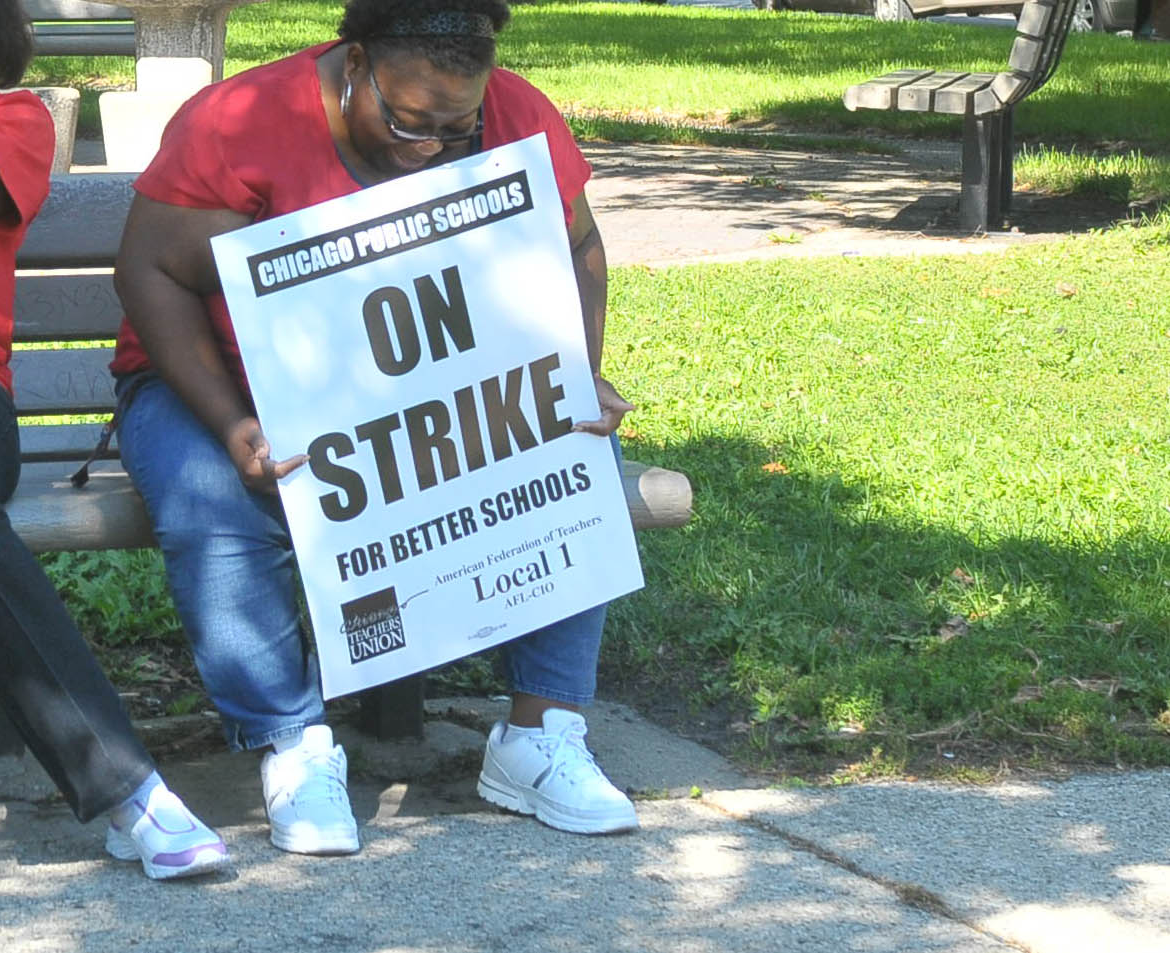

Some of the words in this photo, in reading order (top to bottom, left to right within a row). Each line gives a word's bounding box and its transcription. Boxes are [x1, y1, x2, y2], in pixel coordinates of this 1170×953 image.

[257, 237, 354, 287] CHICAGO
[354, 211, 431, 258] PUBLIC
[431, 181, 525, 233] SCHOOLS
[363, 266, 475, 376] ON
[307, 353, 573, 523] STRIKE
[337, 542, 387, 581] FOR
[390, 507, 478, 564] BETTER
[480, 463, 591, 528] SCHOOLS
[434, 562, 485, 587] American
[486, 539, 541, 566] Federation
[543, 531, 553, 544] of
[555, 516, 603, 539] Teachers
[471, 550, 552, 603] Local
[558, 542, 574, 570] 1
[504, 582, 554, 609] AFL-CIO
[350, 629, 404, 660] UNION
